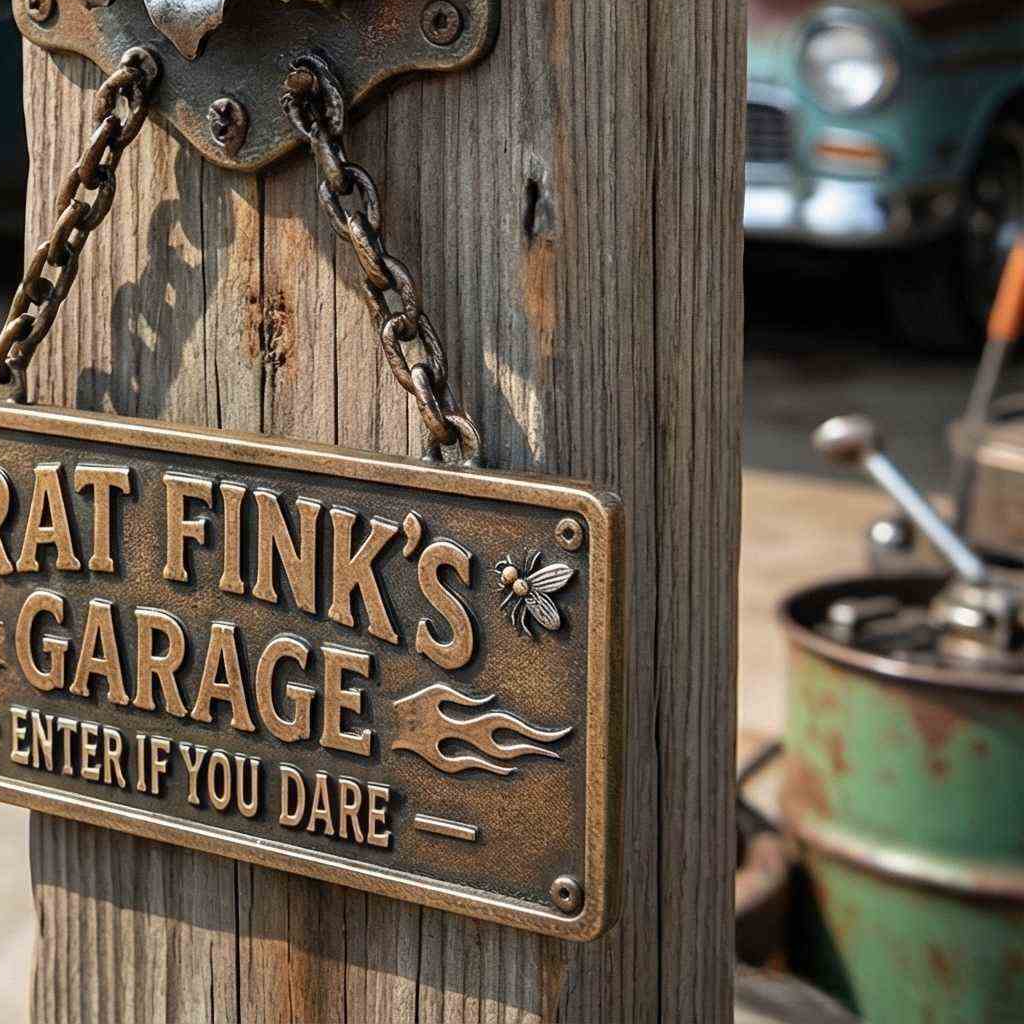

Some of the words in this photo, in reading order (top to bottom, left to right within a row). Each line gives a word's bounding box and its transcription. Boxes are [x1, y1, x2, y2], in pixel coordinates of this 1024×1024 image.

[163, 471, 475, 670] FINK'S
[15, 589, 373, 756] GARAGE
[10, 707, 127, 789] ENTER
[136, 733, 172, 795] IF
[179, 742, 262, 817] YOU
[278, 764, 392, 848] DARE
